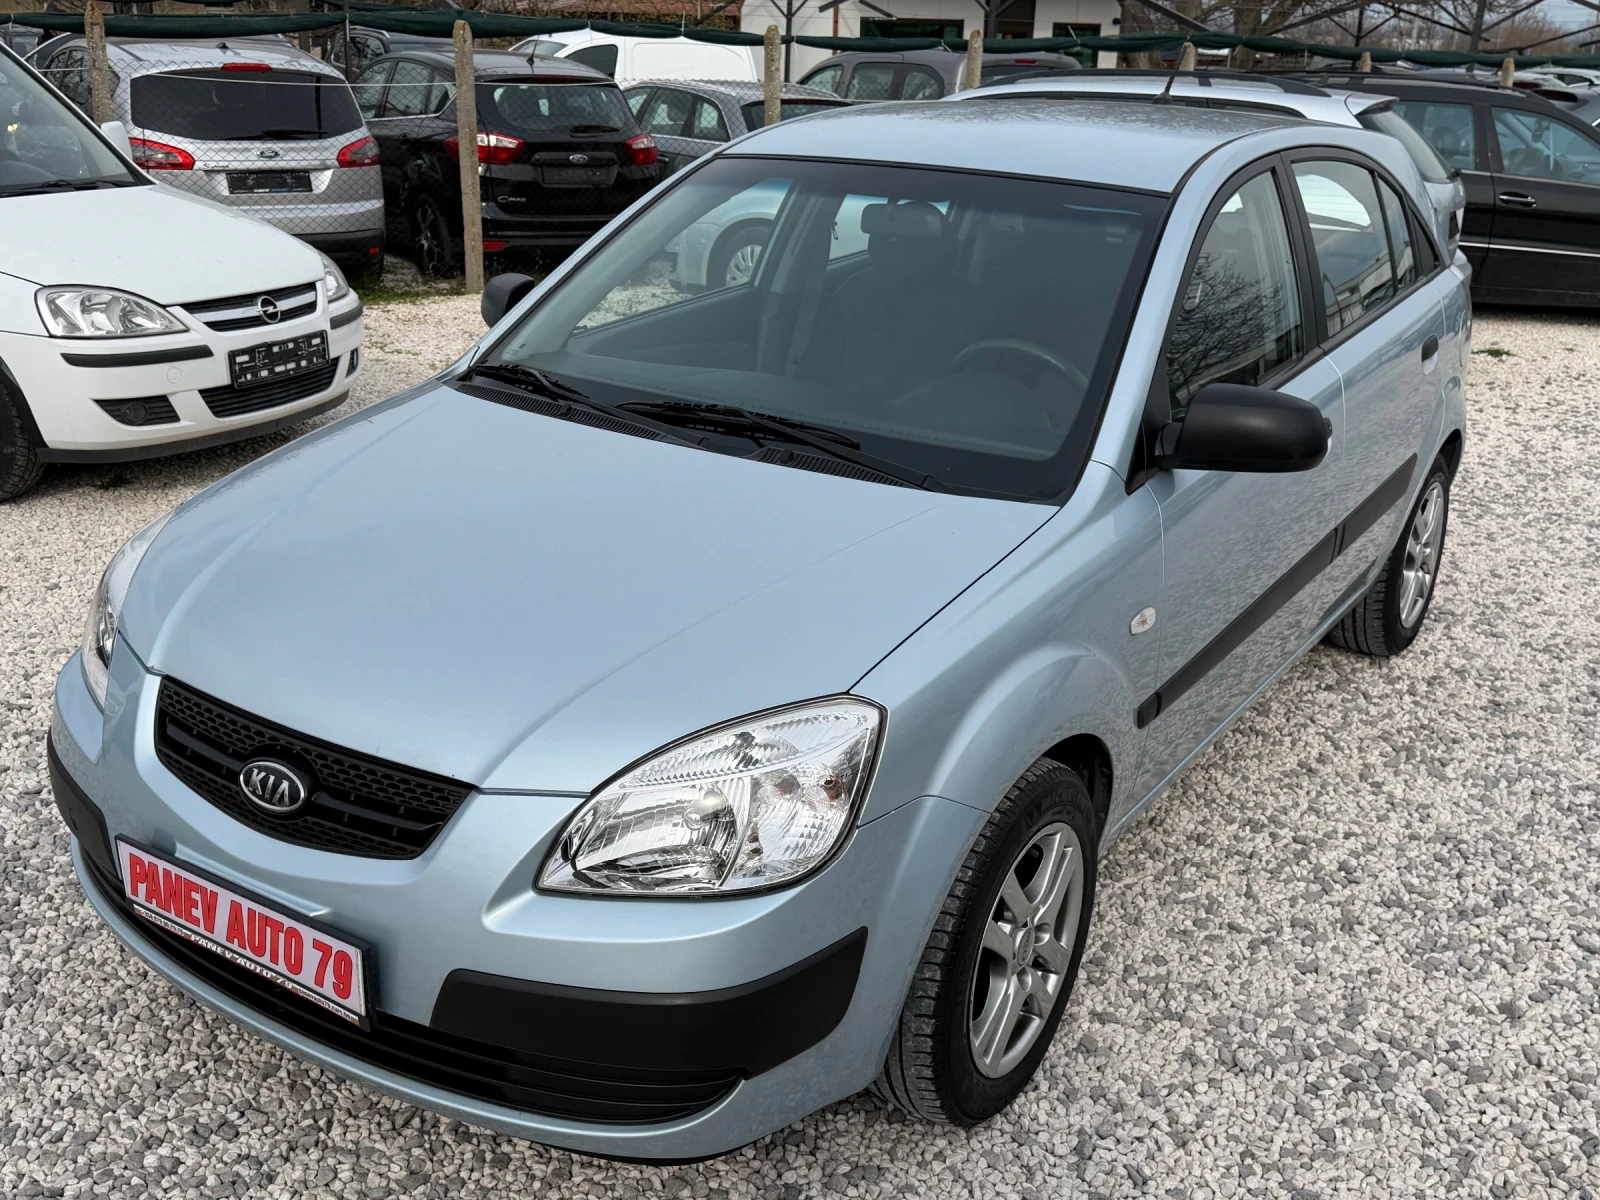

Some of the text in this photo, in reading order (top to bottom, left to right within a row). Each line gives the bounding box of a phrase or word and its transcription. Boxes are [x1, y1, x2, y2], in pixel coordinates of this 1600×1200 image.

[248, 767, 290, 807] KIA
[129, 852, 353, 1000] PANEV AUTO 79
[190, 934, 233, 959] PANEV
[236, 957, 272, 979] AUTO
[276, 975, 293, 989] 79
